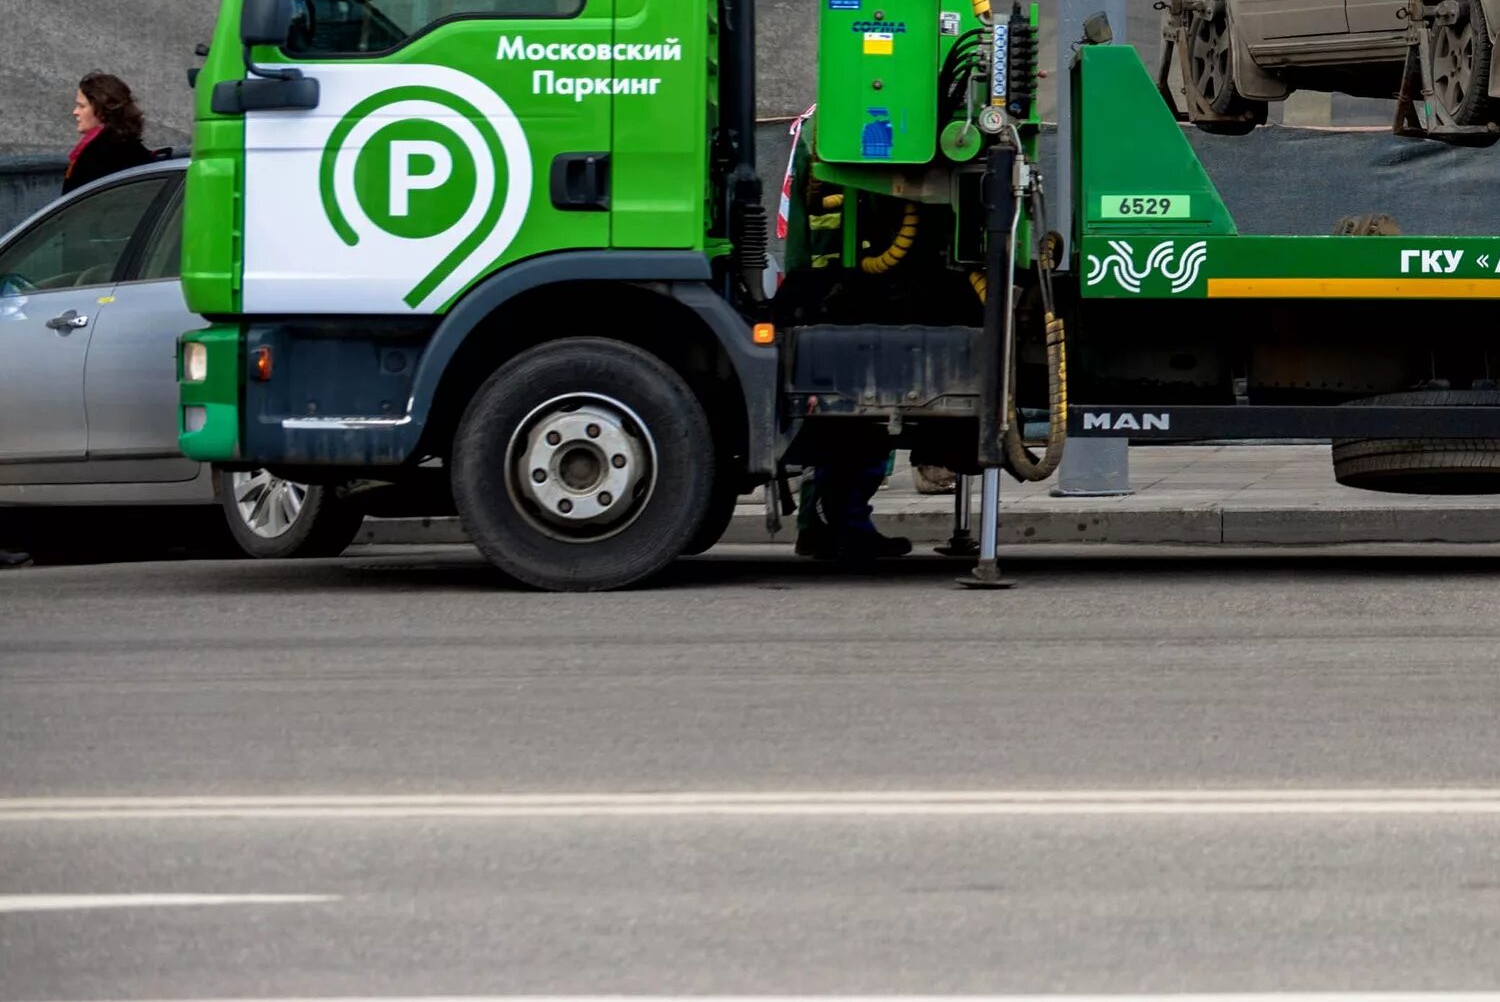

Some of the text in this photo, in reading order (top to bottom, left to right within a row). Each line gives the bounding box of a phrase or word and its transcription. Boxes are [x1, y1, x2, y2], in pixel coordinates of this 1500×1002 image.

[496, 35, 682, 61] Московский
[532, 69, 662, 103] Паркинг
[388, 140, 453, 216] P
[1119, 198, 1171, 215] 6529
[1400, 249, 1464, 274] ГКУ
[1083, 413, 1169, 430] MAN
